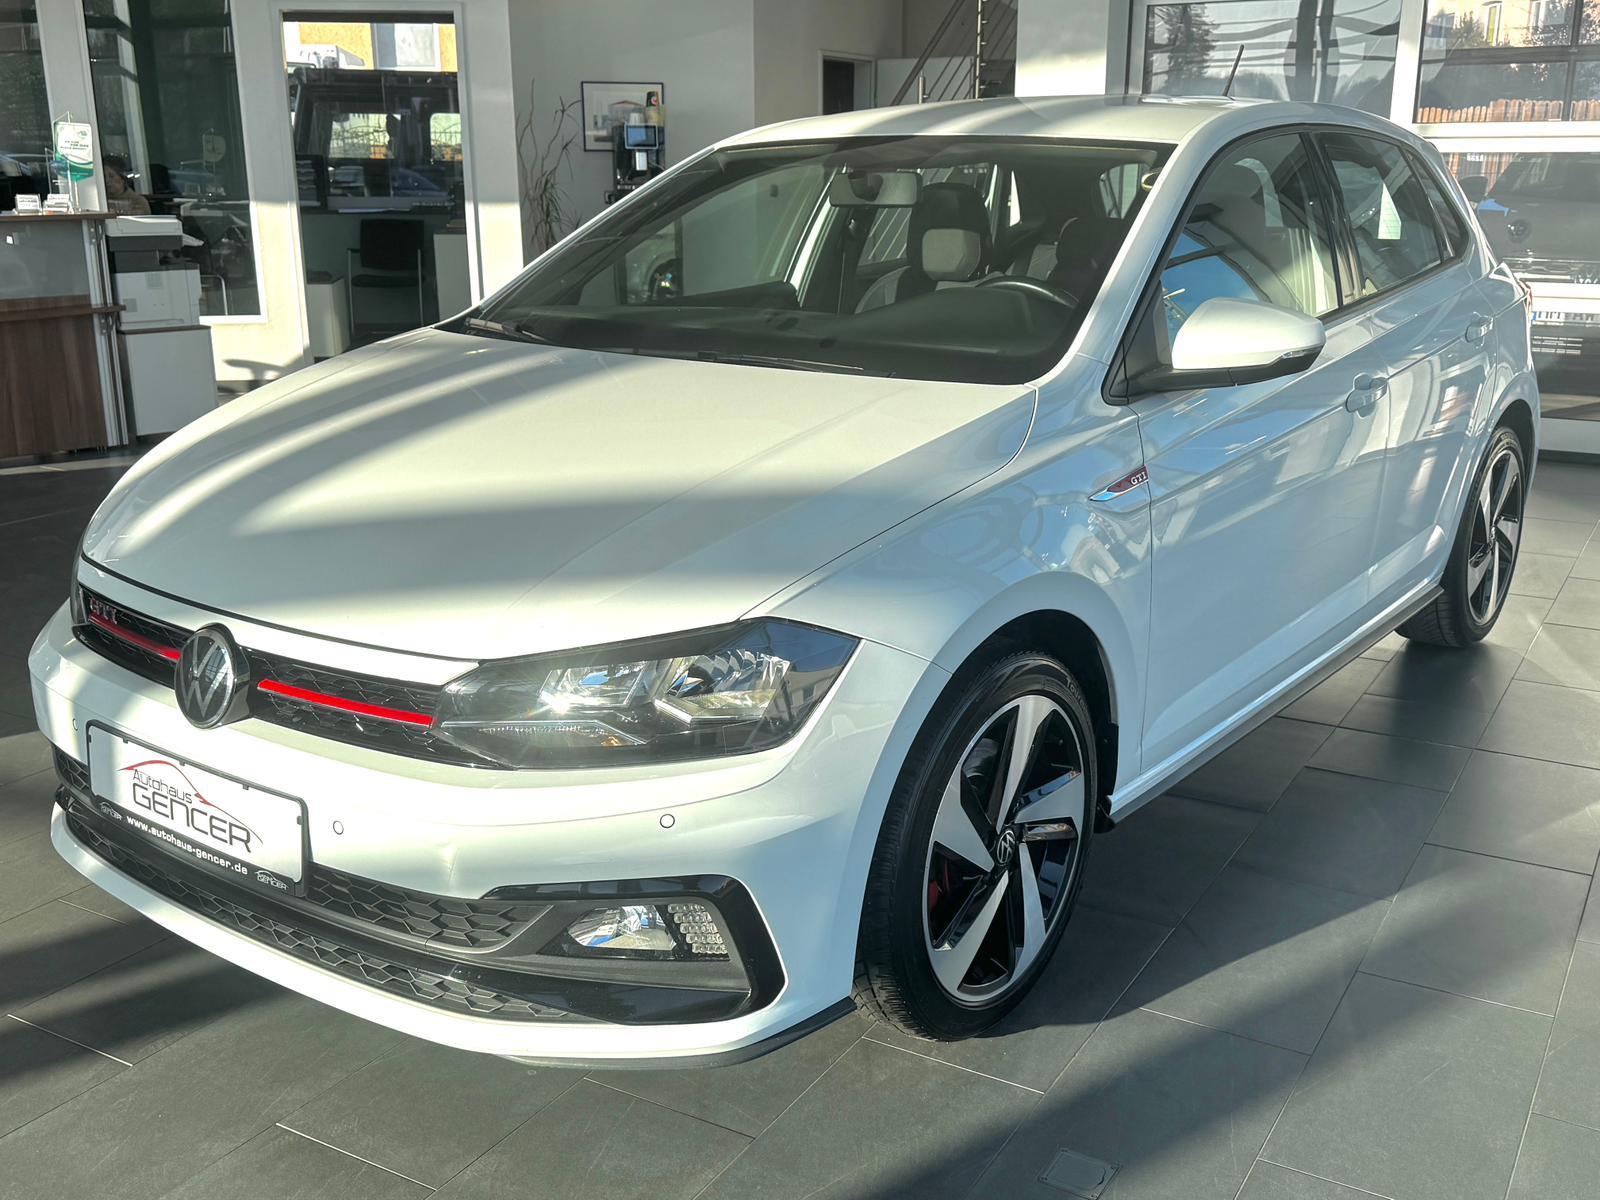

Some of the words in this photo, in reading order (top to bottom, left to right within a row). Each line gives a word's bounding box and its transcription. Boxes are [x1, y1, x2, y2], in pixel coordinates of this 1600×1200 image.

[1130, 471, 1147, 485] GTI
[133, 769, 193, 804] Autohaus
[132, 783, 252, 854] GENCER
[126, 815, 248, 875] www.autohaus-gencer.de
